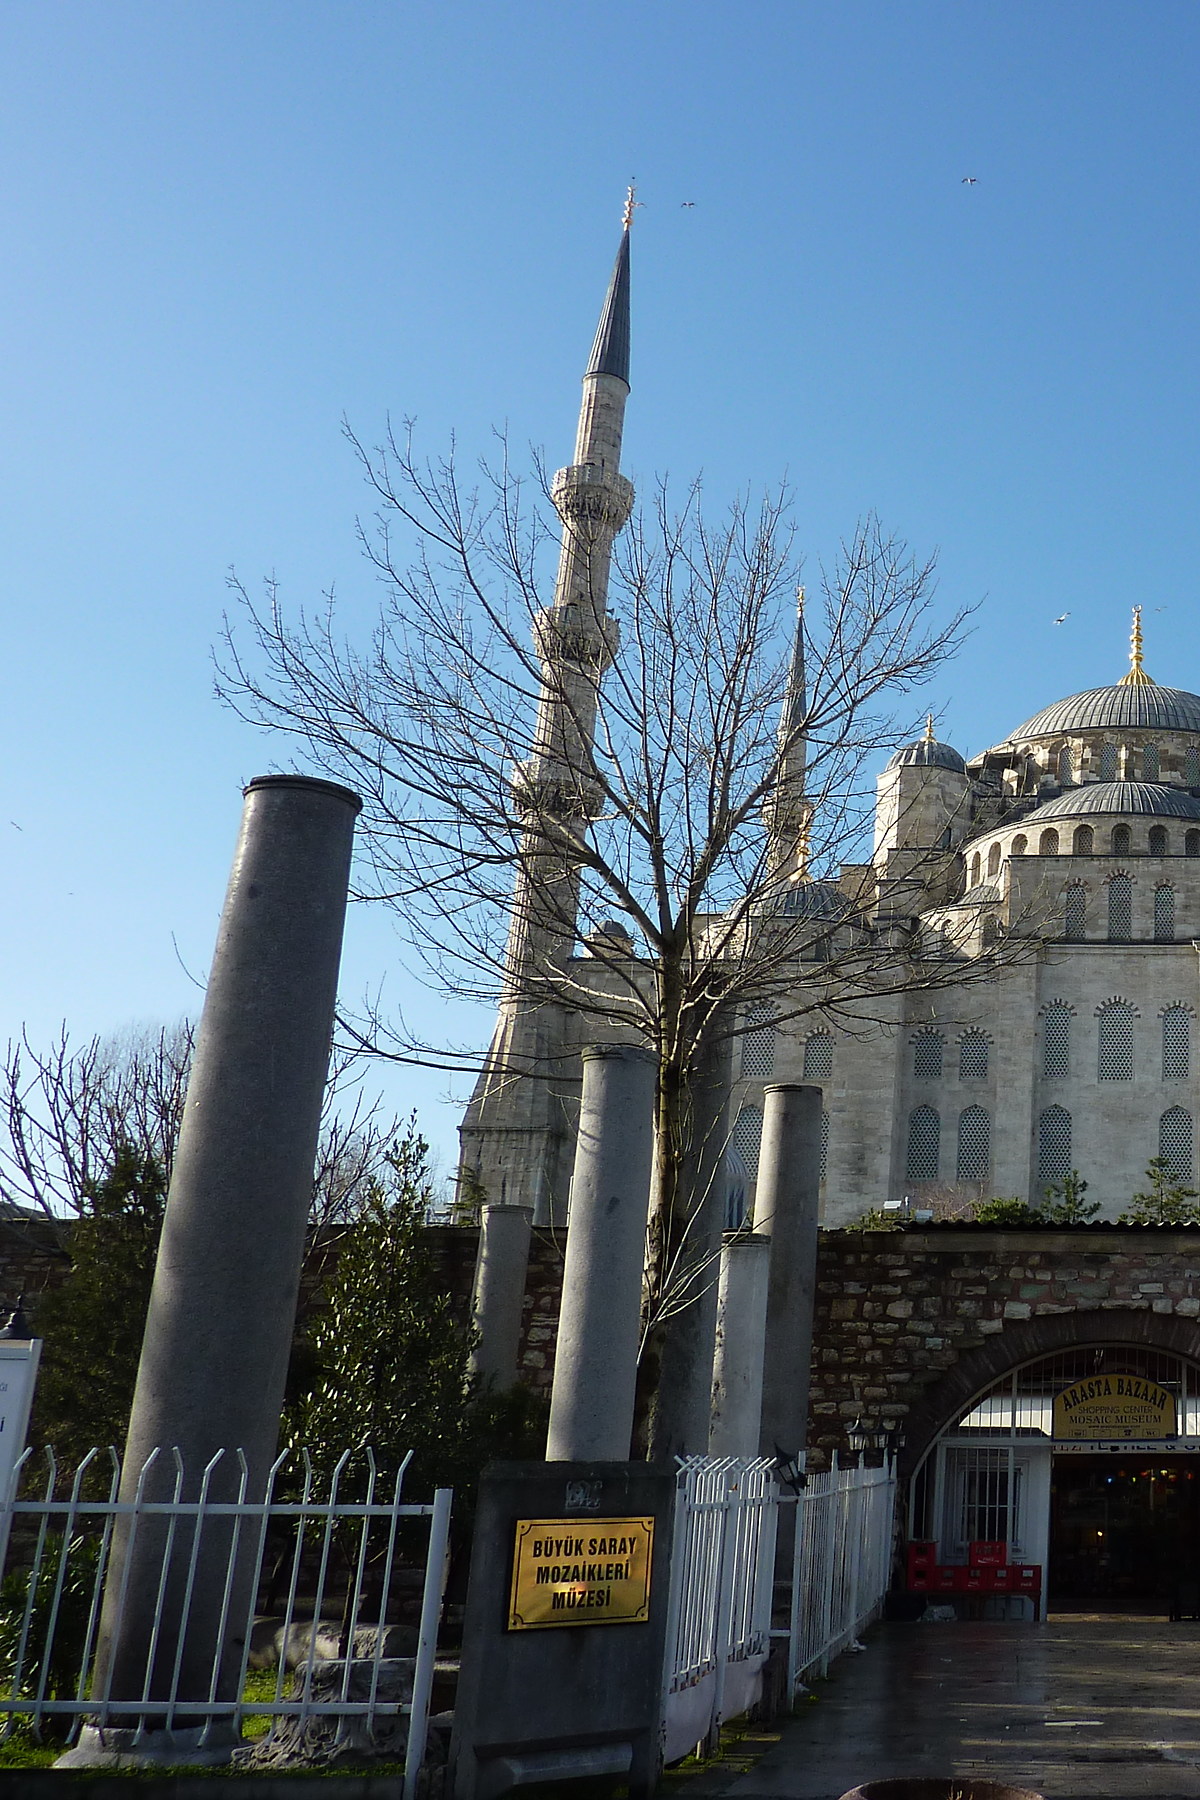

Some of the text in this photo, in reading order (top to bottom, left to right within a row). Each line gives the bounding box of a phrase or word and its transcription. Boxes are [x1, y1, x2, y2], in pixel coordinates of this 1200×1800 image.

[1063, 1379, 1167, 1411] ARASTA BAZAAR
[1069, 1415, 1161, 1425] MOSAIC MUSEUM
[1078, 1405, 1153, 1415] SHOPPING CENTER
[533, 1536, 637, 1558] BÜYÜK SARAY
[536, 1560, 629, 1584] MOZAİKLERİ
[552, 1586, 611, 1610] MÜZESİ
